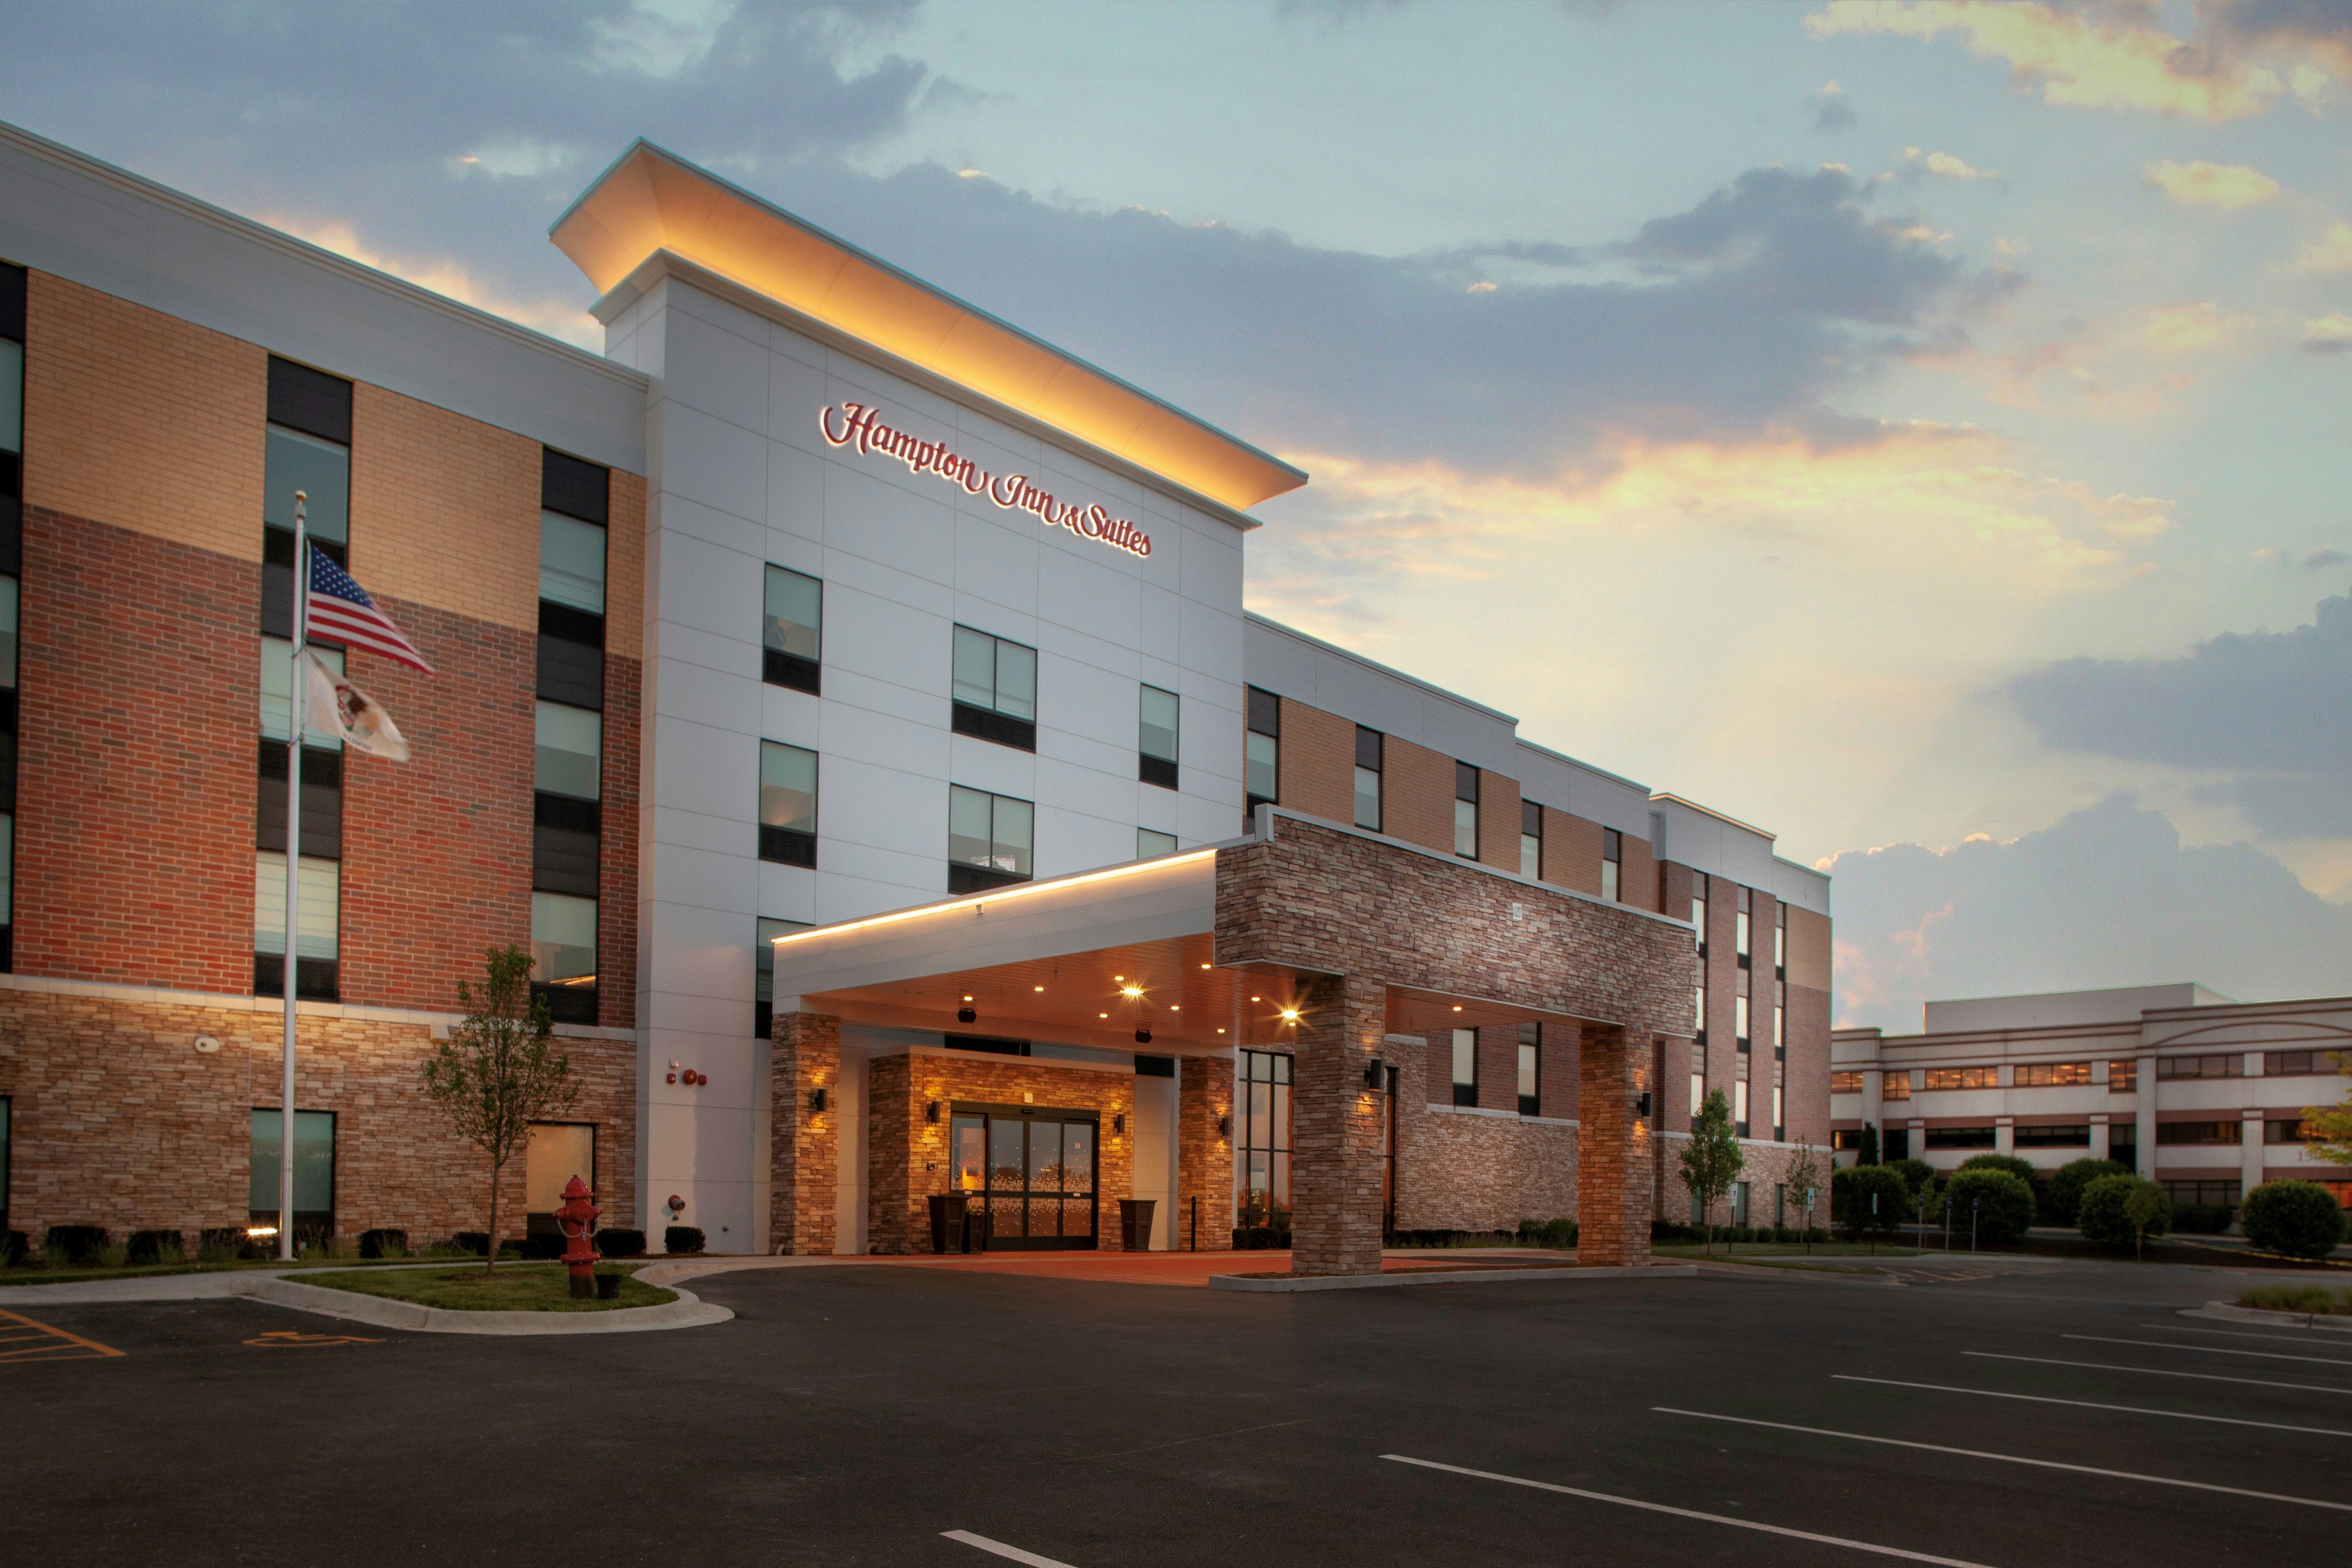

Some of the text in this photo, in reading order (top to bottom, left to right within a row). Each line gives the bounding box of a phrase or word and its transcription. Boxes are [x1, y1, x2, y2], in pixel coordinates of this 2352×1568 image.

[822, 403, 1151, 556] Hampton Inn & Suites
